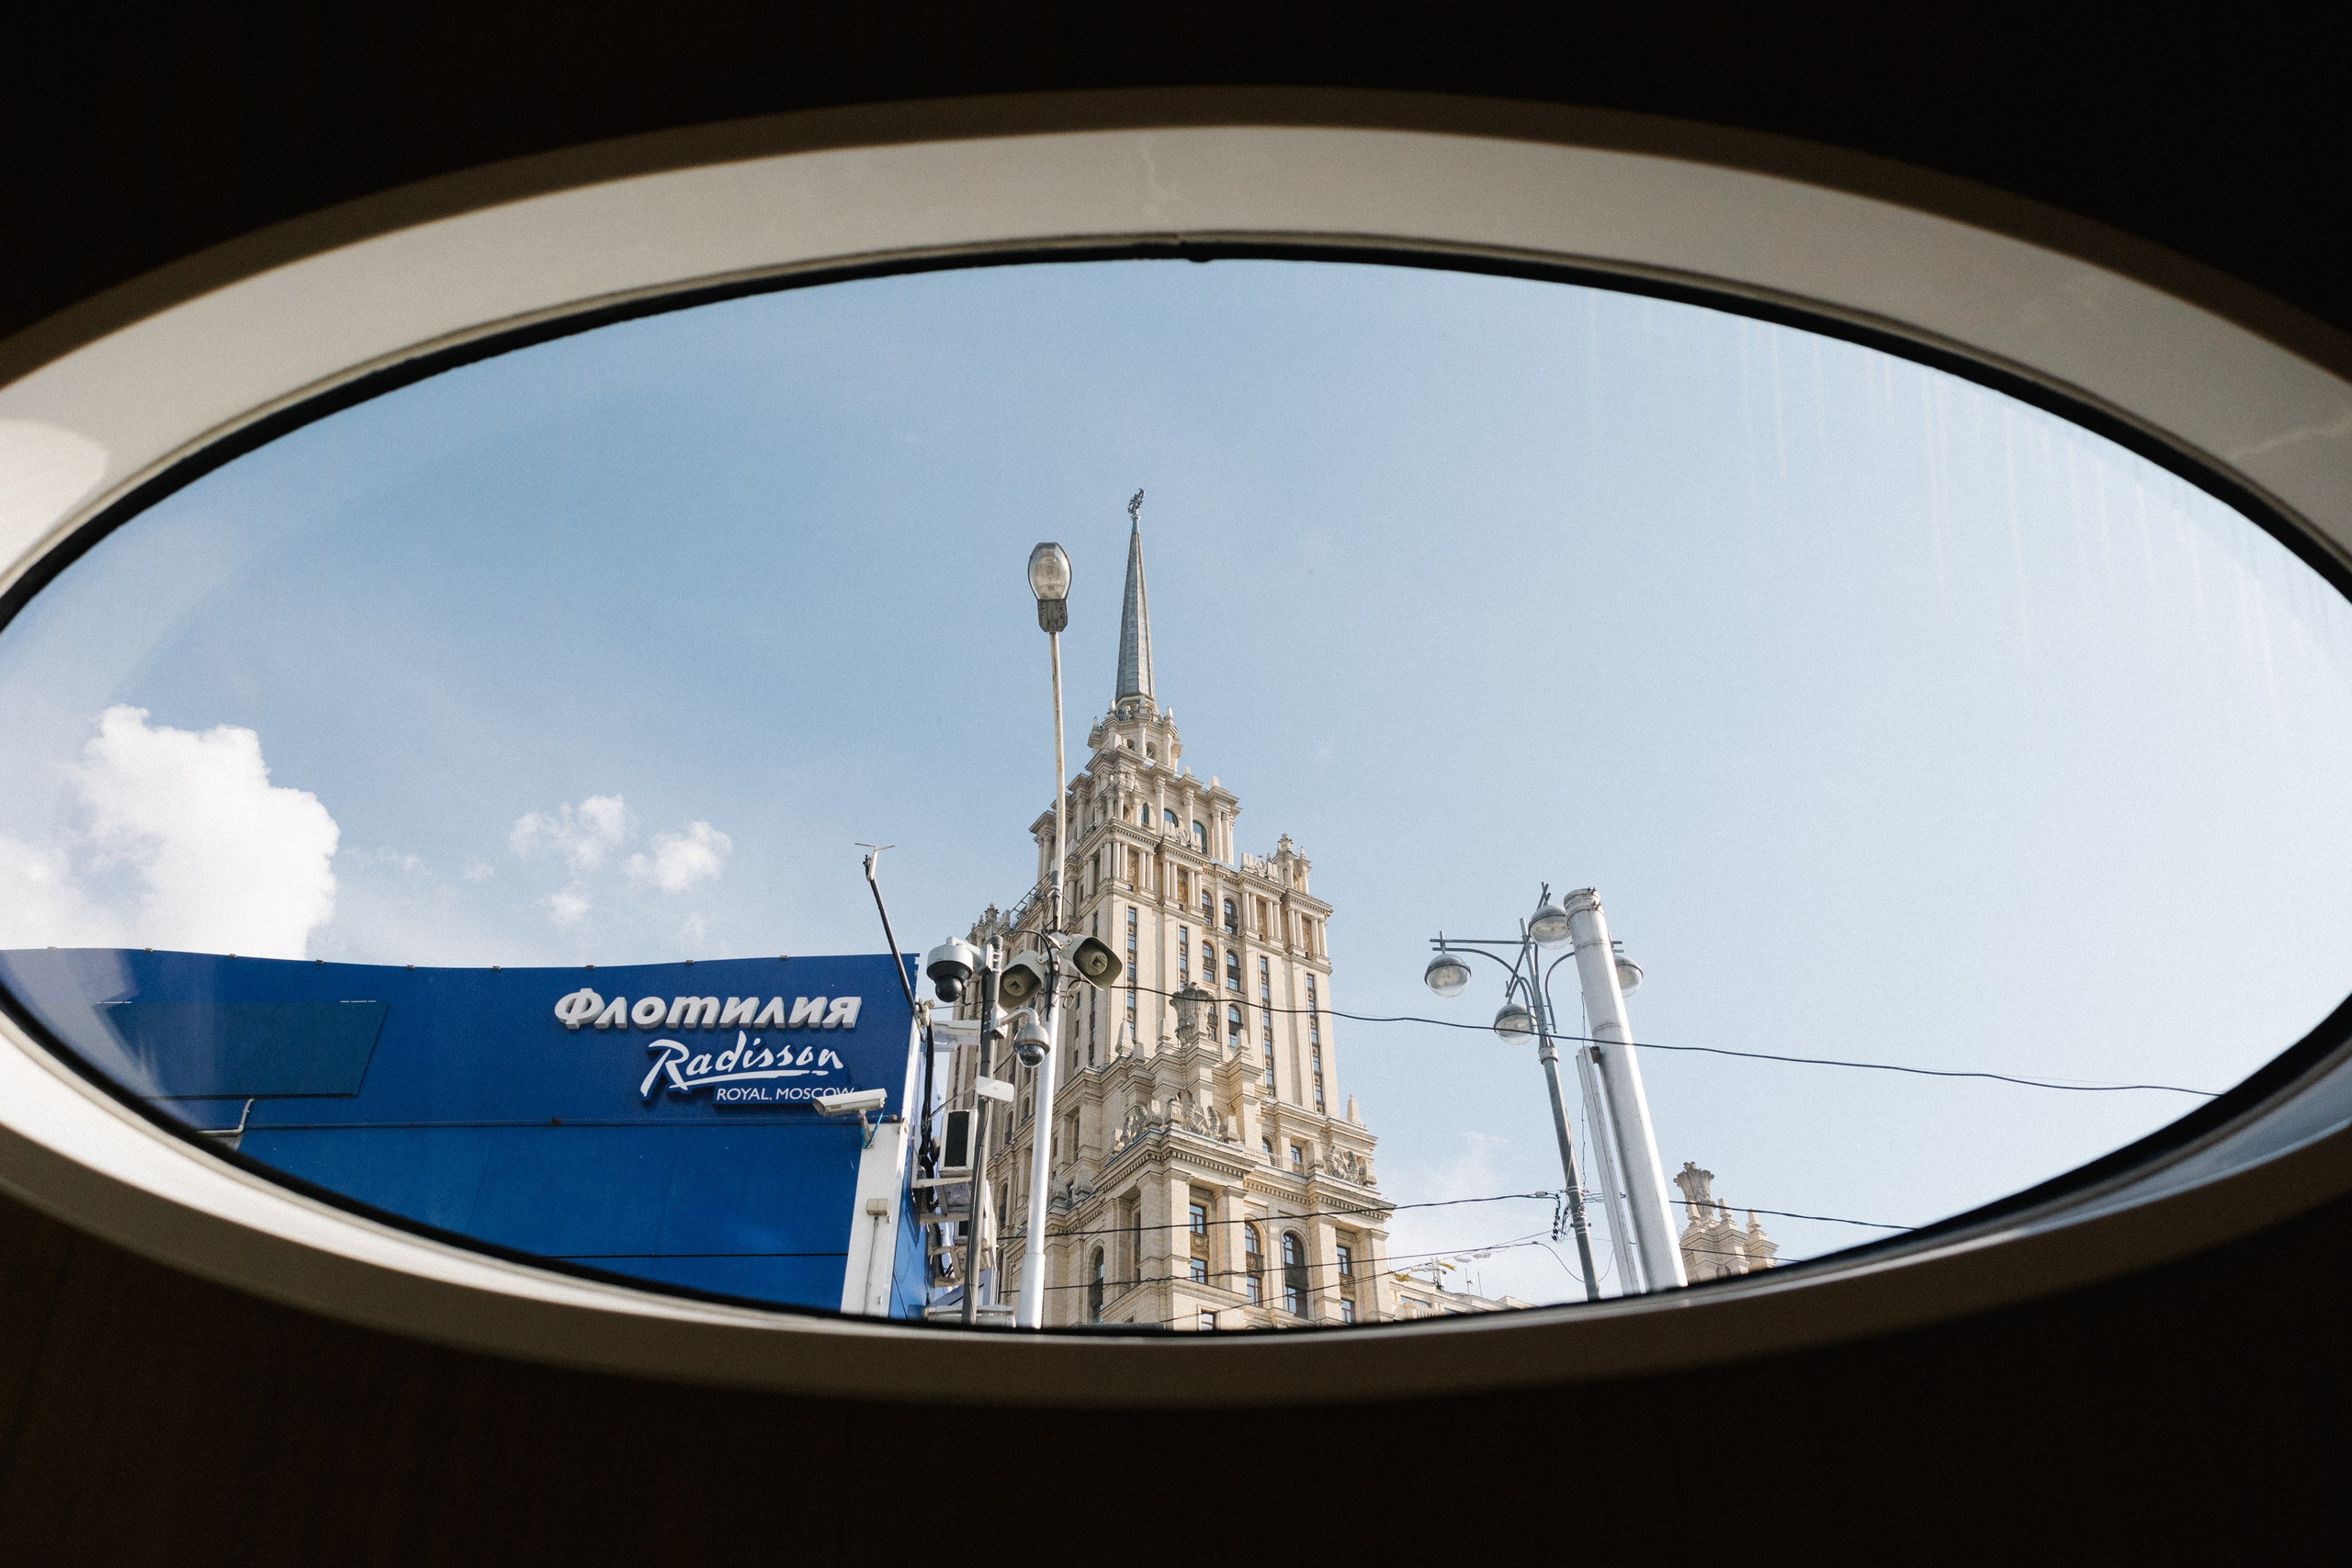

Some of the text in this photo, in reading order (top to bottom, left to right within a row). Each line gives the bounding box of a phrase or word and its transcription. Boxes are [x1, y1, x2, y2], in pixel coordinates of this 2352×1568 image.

[555, 987, 862, 1029] Флотилия
[640, 1031, 843, 1097] Radisson
[716, 1088, 773, 1101] ROYAL,
